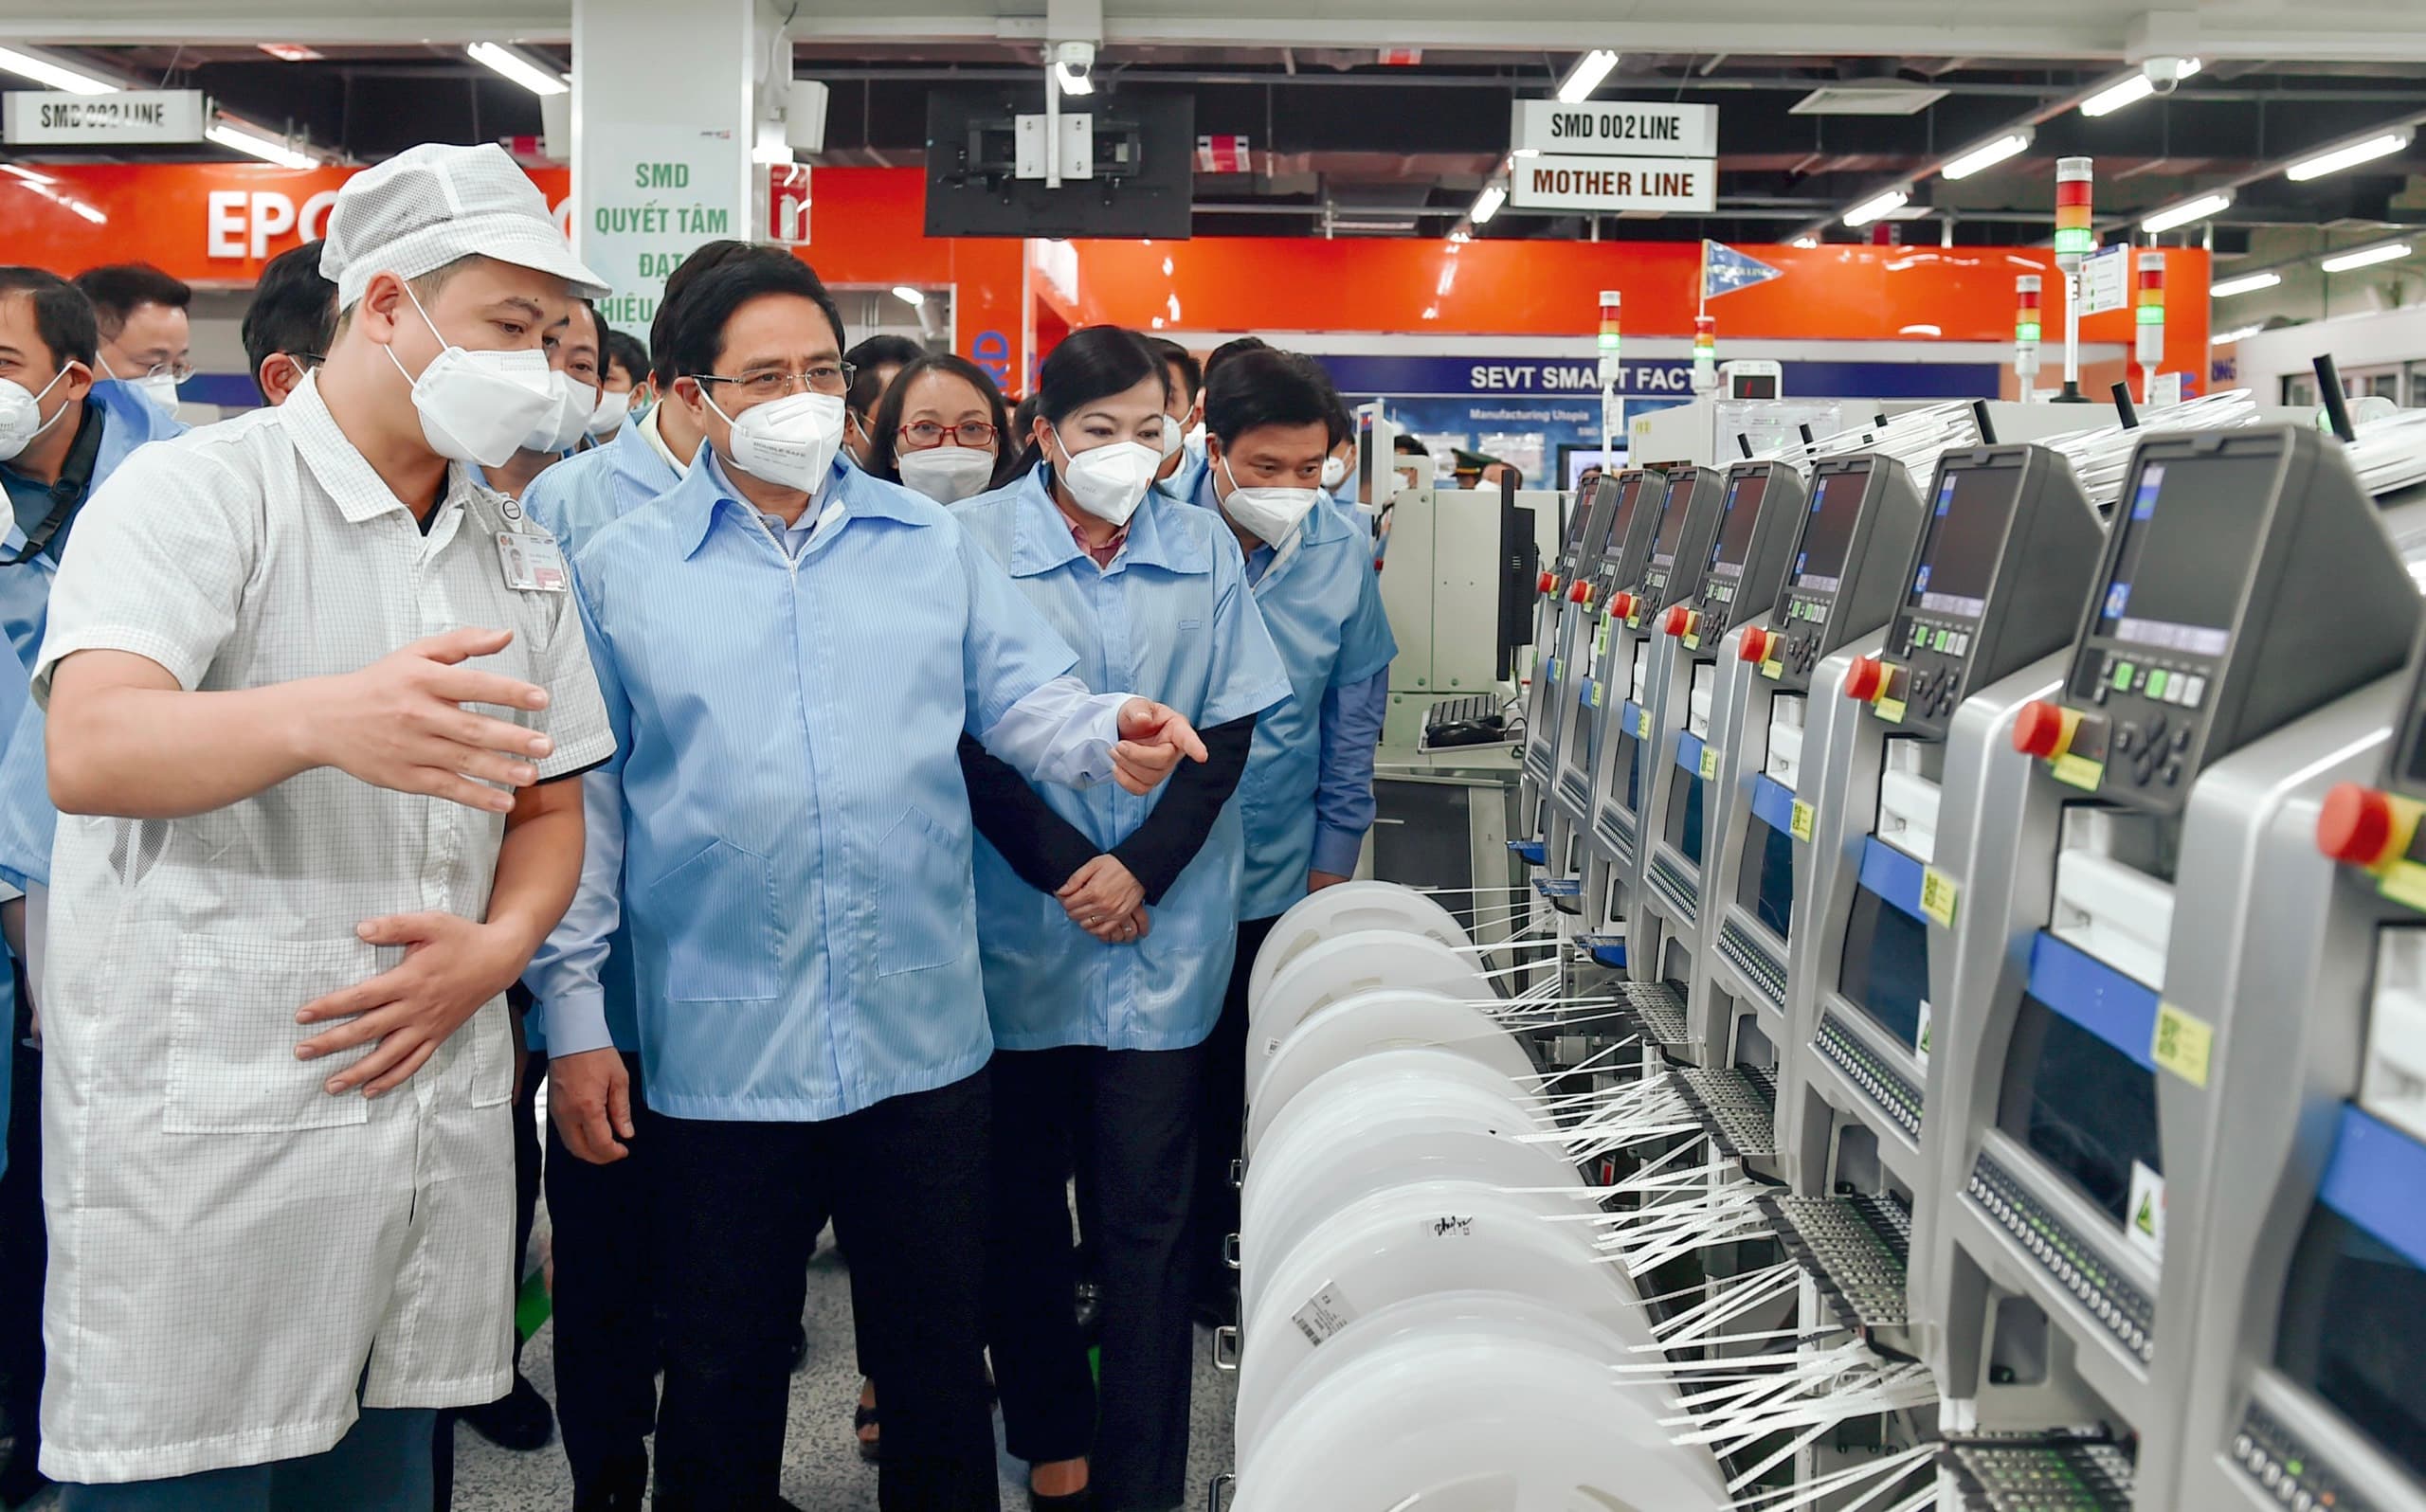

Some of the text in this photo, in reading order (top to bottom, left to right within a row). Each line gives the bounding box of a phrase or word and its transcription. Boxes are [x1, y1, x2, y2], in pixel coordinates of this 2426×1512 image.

[1551, 113, 1680, 140] SMD 002 LINE
[636, 162, 689, 189] SMD
[1532, 169, 1694, 197] MOTHER LINE
[595, 198, 728, 235] QUYẾT TÂM
[1470, 366, 1536, 390] SEVT
[1637, 367, 1717, 391] FACT
